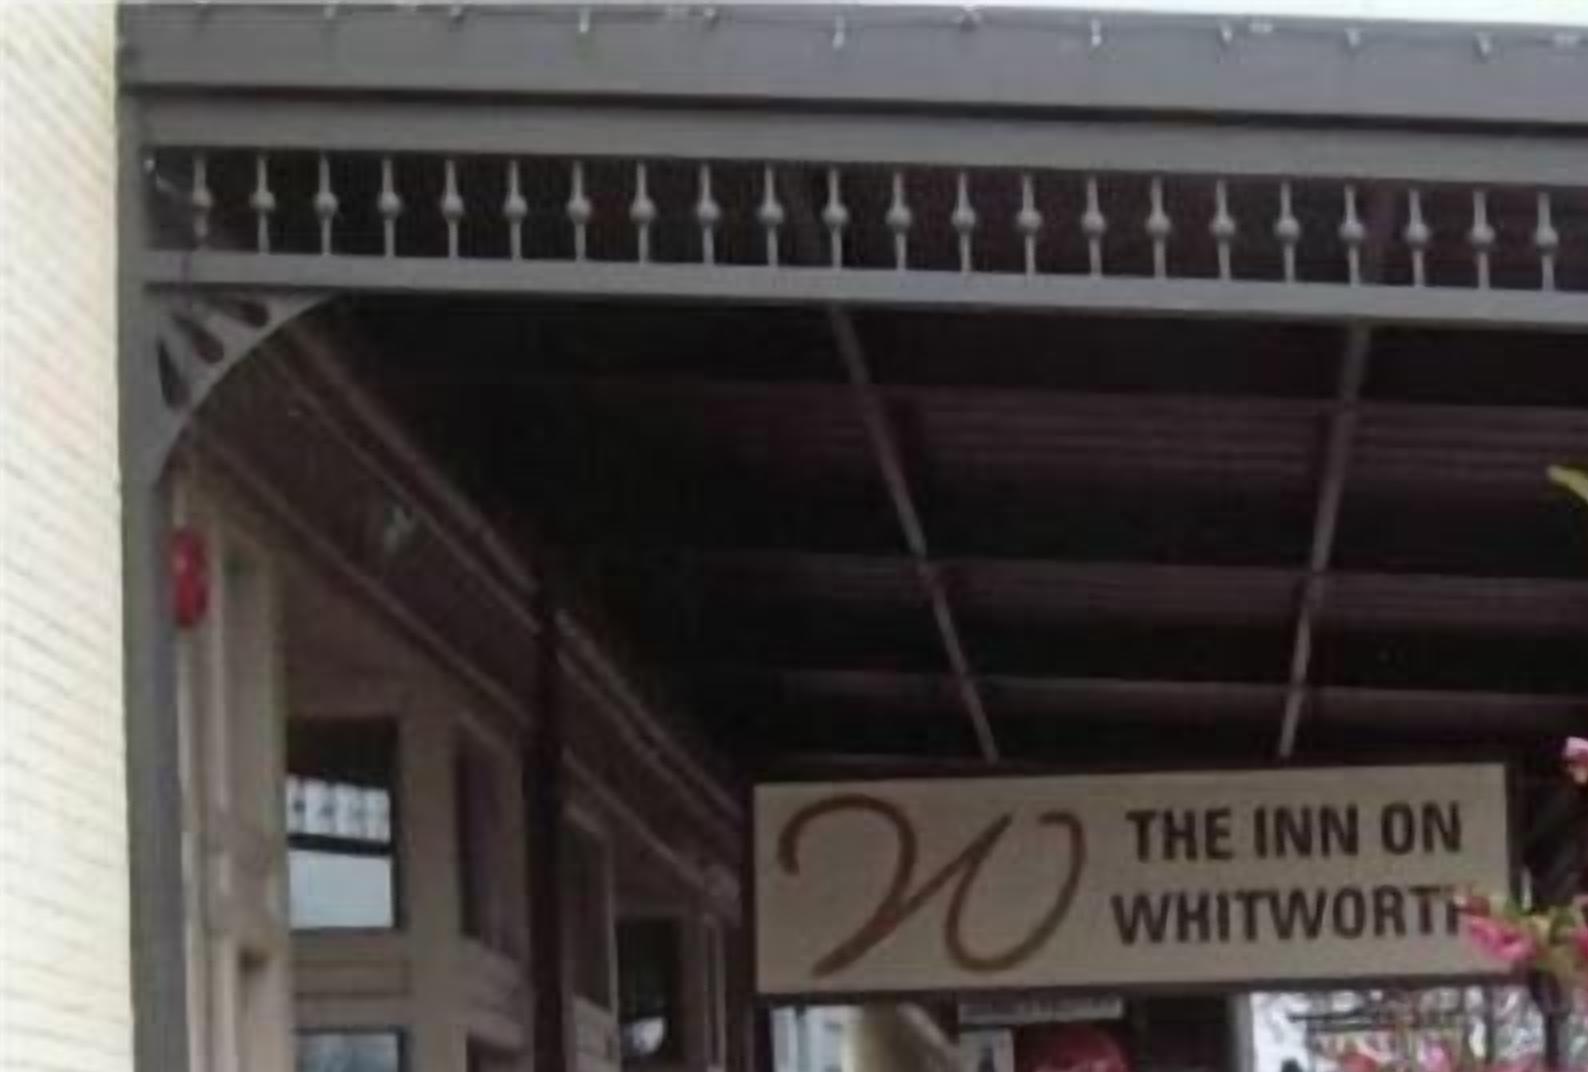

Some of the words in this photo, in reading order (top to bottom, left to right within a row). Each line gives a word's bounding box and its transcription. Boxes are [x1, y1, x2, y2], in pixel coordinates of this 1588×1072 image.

[1127, 805, 1234, 862] THE
[1253, 802, 1360, 858] INN
[1381, 800, 1462, 854] ON
